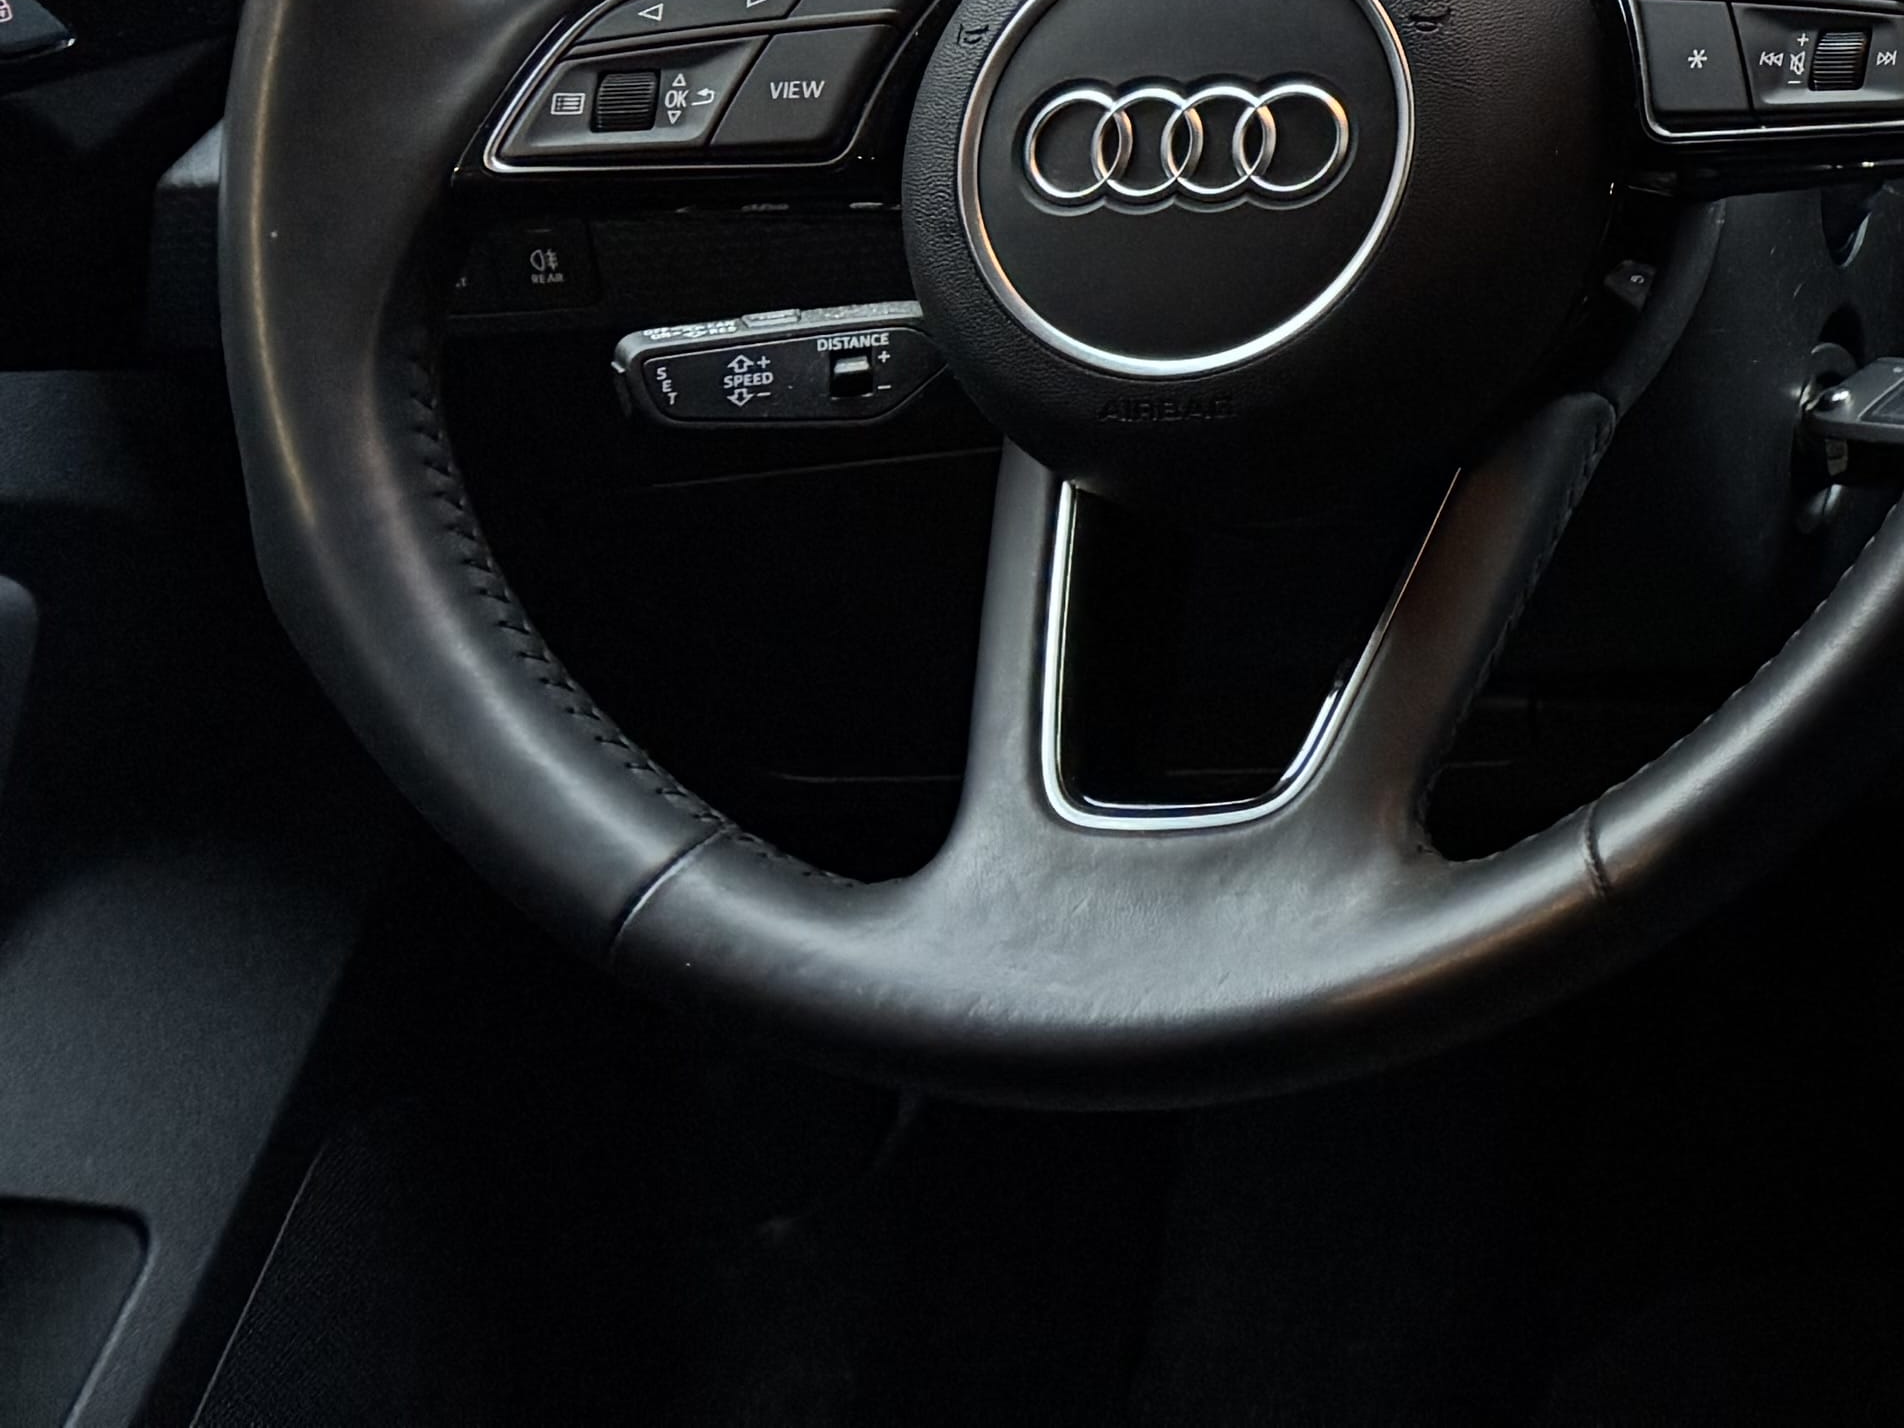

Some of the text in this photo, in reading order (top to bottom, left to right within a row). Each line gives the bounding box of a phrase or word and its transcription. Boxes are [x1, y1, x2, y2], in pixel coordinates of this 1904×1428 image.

[664, 90, 689, 108] OK
[769, 81, 825, 100] VIEW
[817, 333, 889, 352] DISTANCE
[724, 372, 773, 389] SPEED
